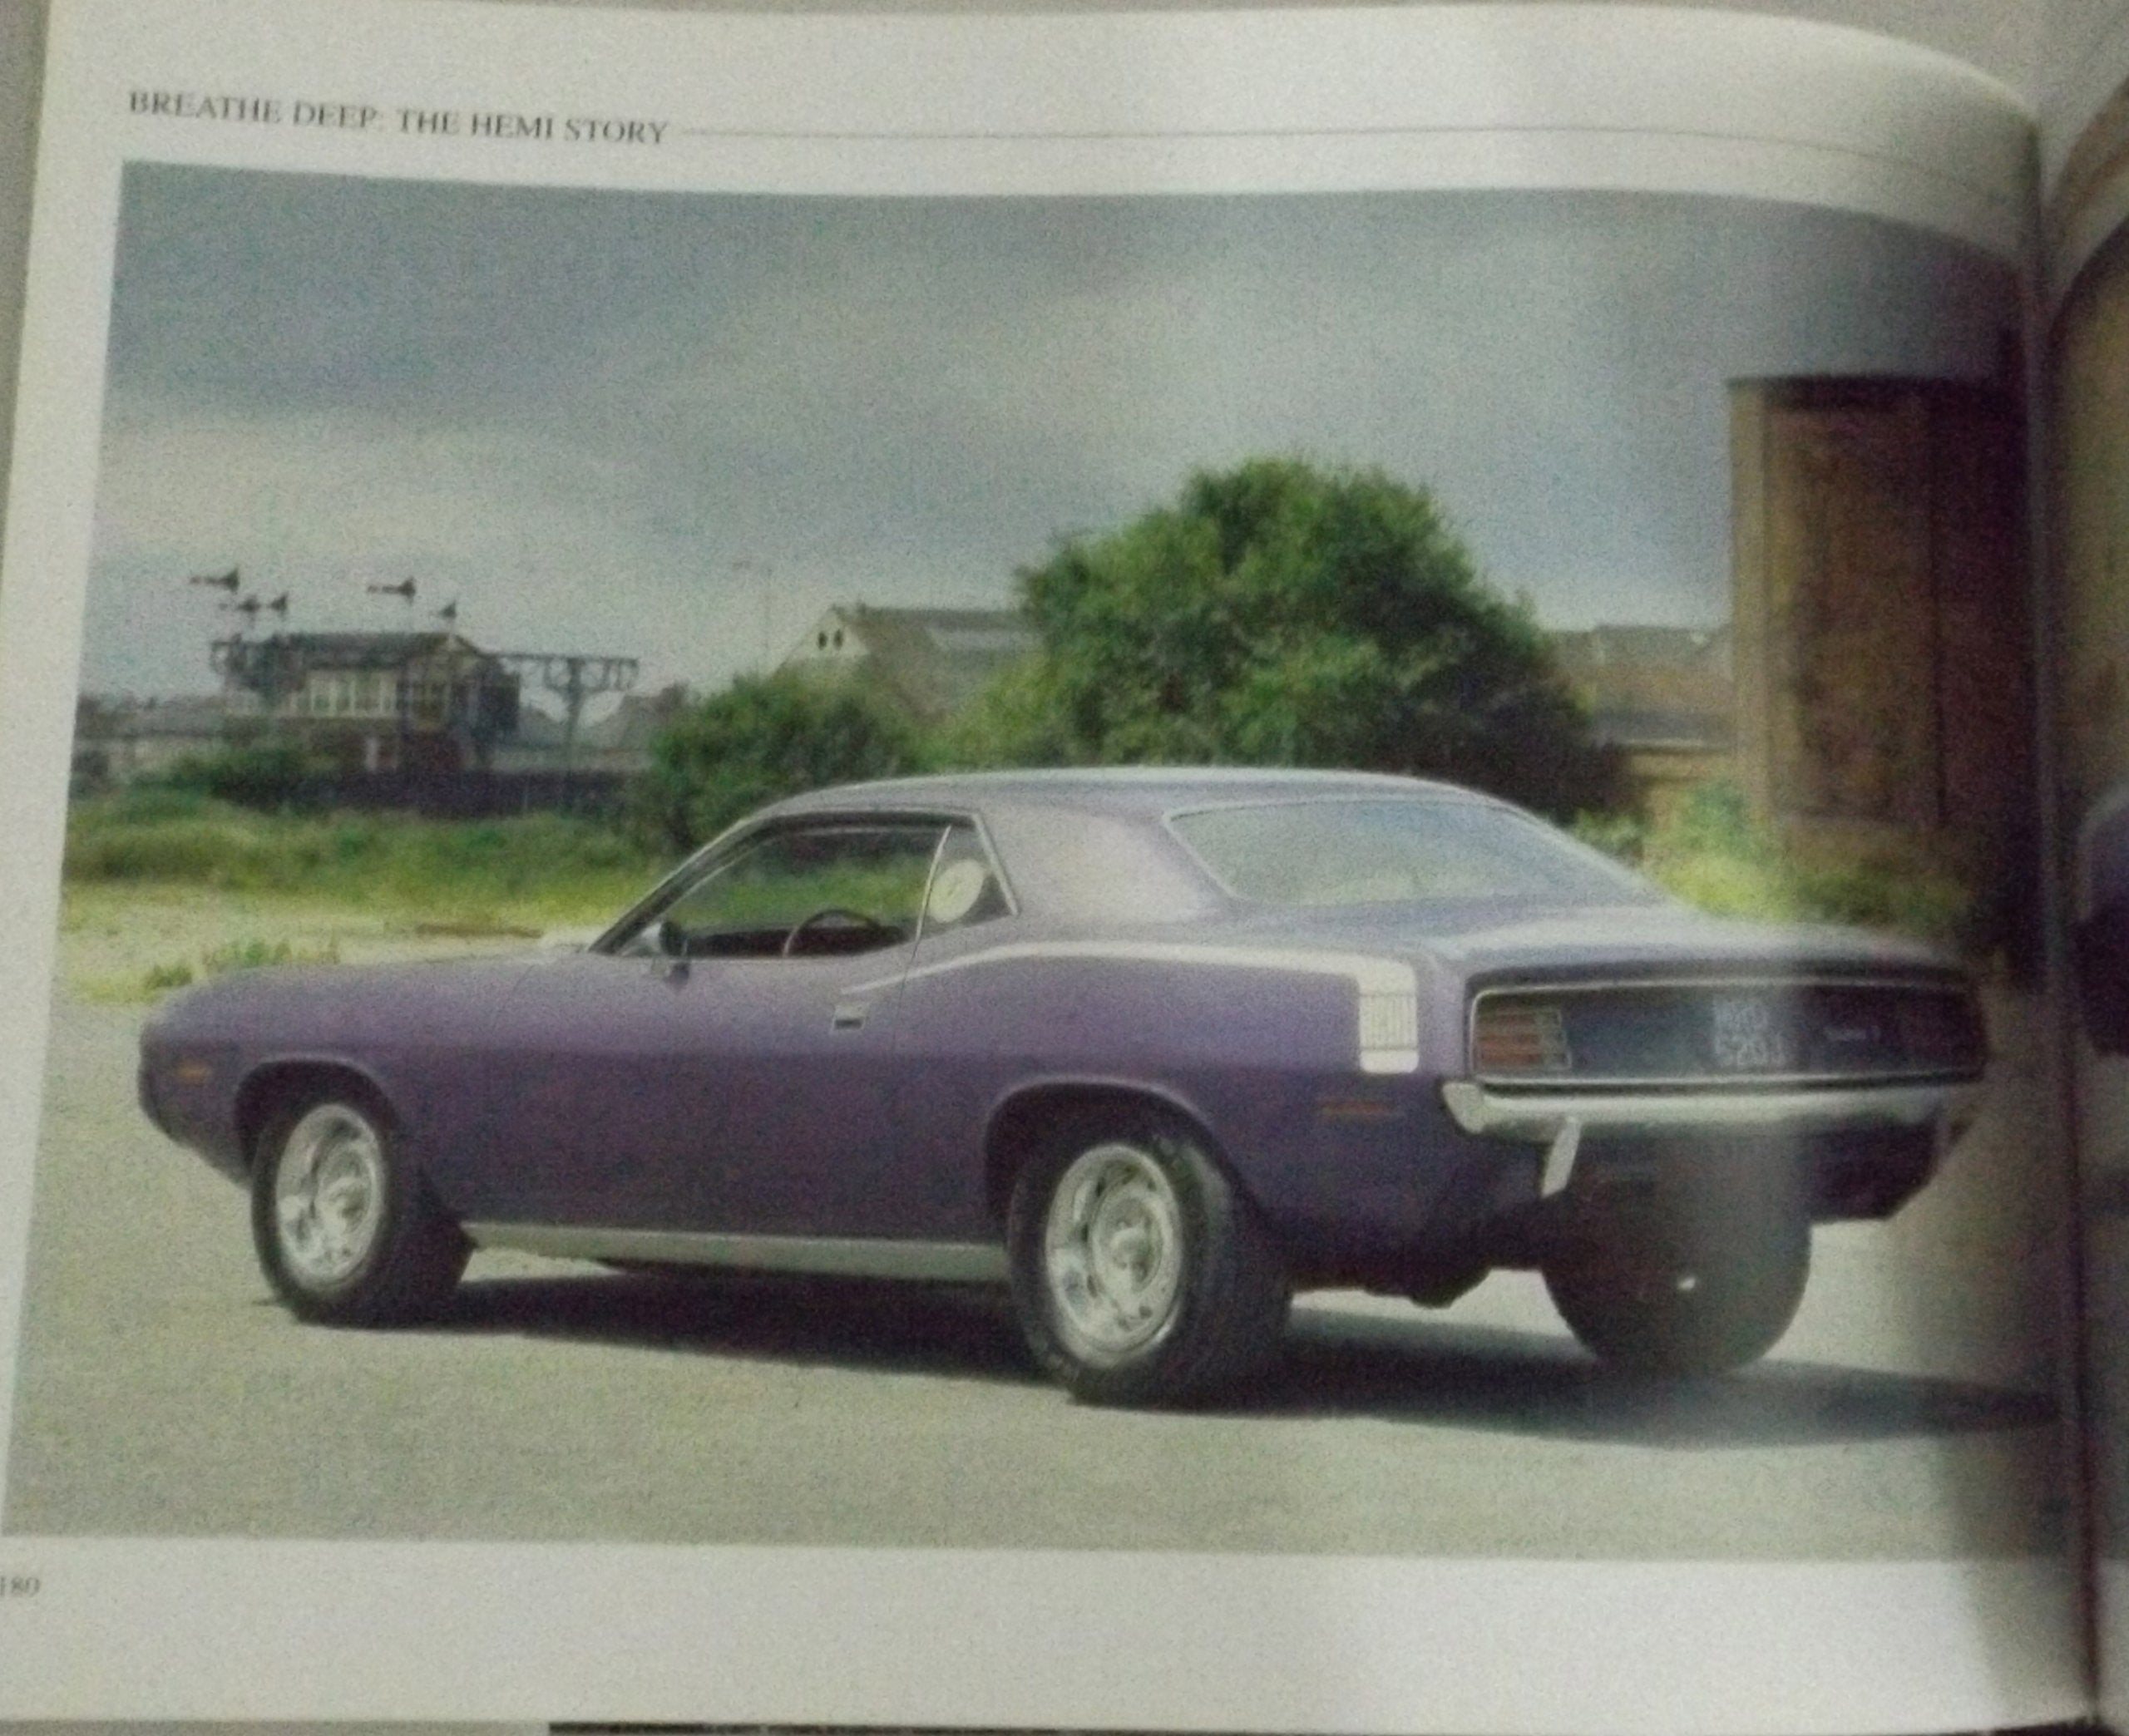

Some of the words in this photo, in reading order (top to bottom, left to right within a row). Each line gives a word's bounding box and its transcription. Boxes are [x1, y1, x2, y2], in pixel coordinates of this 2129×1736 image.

[129, 91, 281, 124] BREATHE
[397, 107, 459, 135] THE
[471, 112, 554, 141] HEMI
[565, 117, 669, 145] STORY
